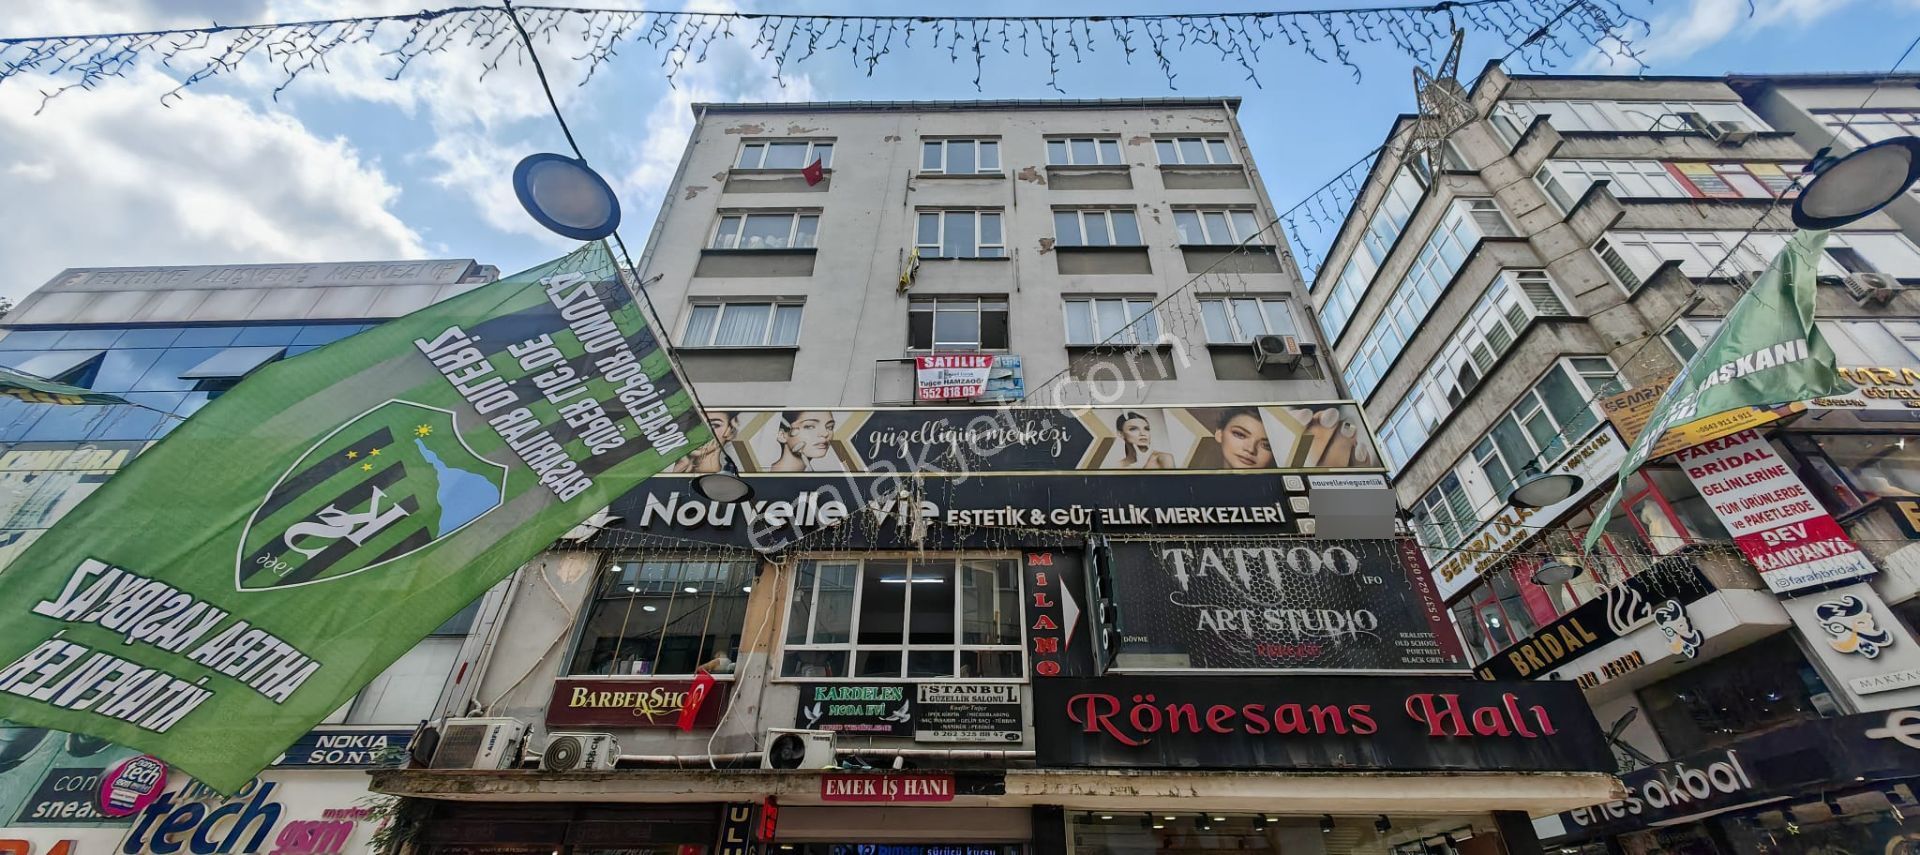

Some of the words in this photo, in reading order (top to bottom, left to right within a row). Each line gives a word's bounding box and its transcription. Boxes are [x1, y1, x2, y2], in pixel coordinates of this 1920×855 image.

[924, 356, 986, 368] SATILIK
[1701, 339, 1809, 392] AŞKANI
[922, 388, 941, 399] 552
[869, 420, 977, 459] güzelliğin
[986, 419, 1071, 458] merkezi
[1675, 428, 1760, 462] FARAH
[1688, 448, 1774, 480] BRİDAL
[1702, 464, 1789, 497] GELİNLERİNE
[947, 504, 1026, 526] ESTETİK
[1030, 508, 1047, 526] &
[1051, 503, 1152, 526] GÜZELLİK
[1154, 501, 1287, 525] MERKEZLERİ
[1715, 500, 1740, 517] TÜM
[1742, 484, 1806, 511] ÜRÜNLERDE
[1744, 499, 1815, 528] PAKETLERDE
[1761, 522, 1808, 546] DEV
[1753, 537, 1854, 571] KAMPANYA
[1163, 547, 1359, 591] TATTOO
[1197, 609, 1252, 638] ART
[1265, 608, 1379, 642] STUDIO
[814, 686, 904, 701] KARDELEN
[920, 685, 1018, 703] İSTANBUL
[971, 695, 1004, 703] SALONU
[1066, 692, 1380, 747] Rönesans
[1406, 692, 1559, 739] Halı
[315, 735, 389, 749] NOKIA
[307, 750, 380, 765] SONY
[123, 762, 160, 787] tech
[825, 778, 876, 796] EMEK
[882, 774, 898, 800] İŞ
[903, 778, 949, 797] HANI
[122, 781, 286, 855] tech
